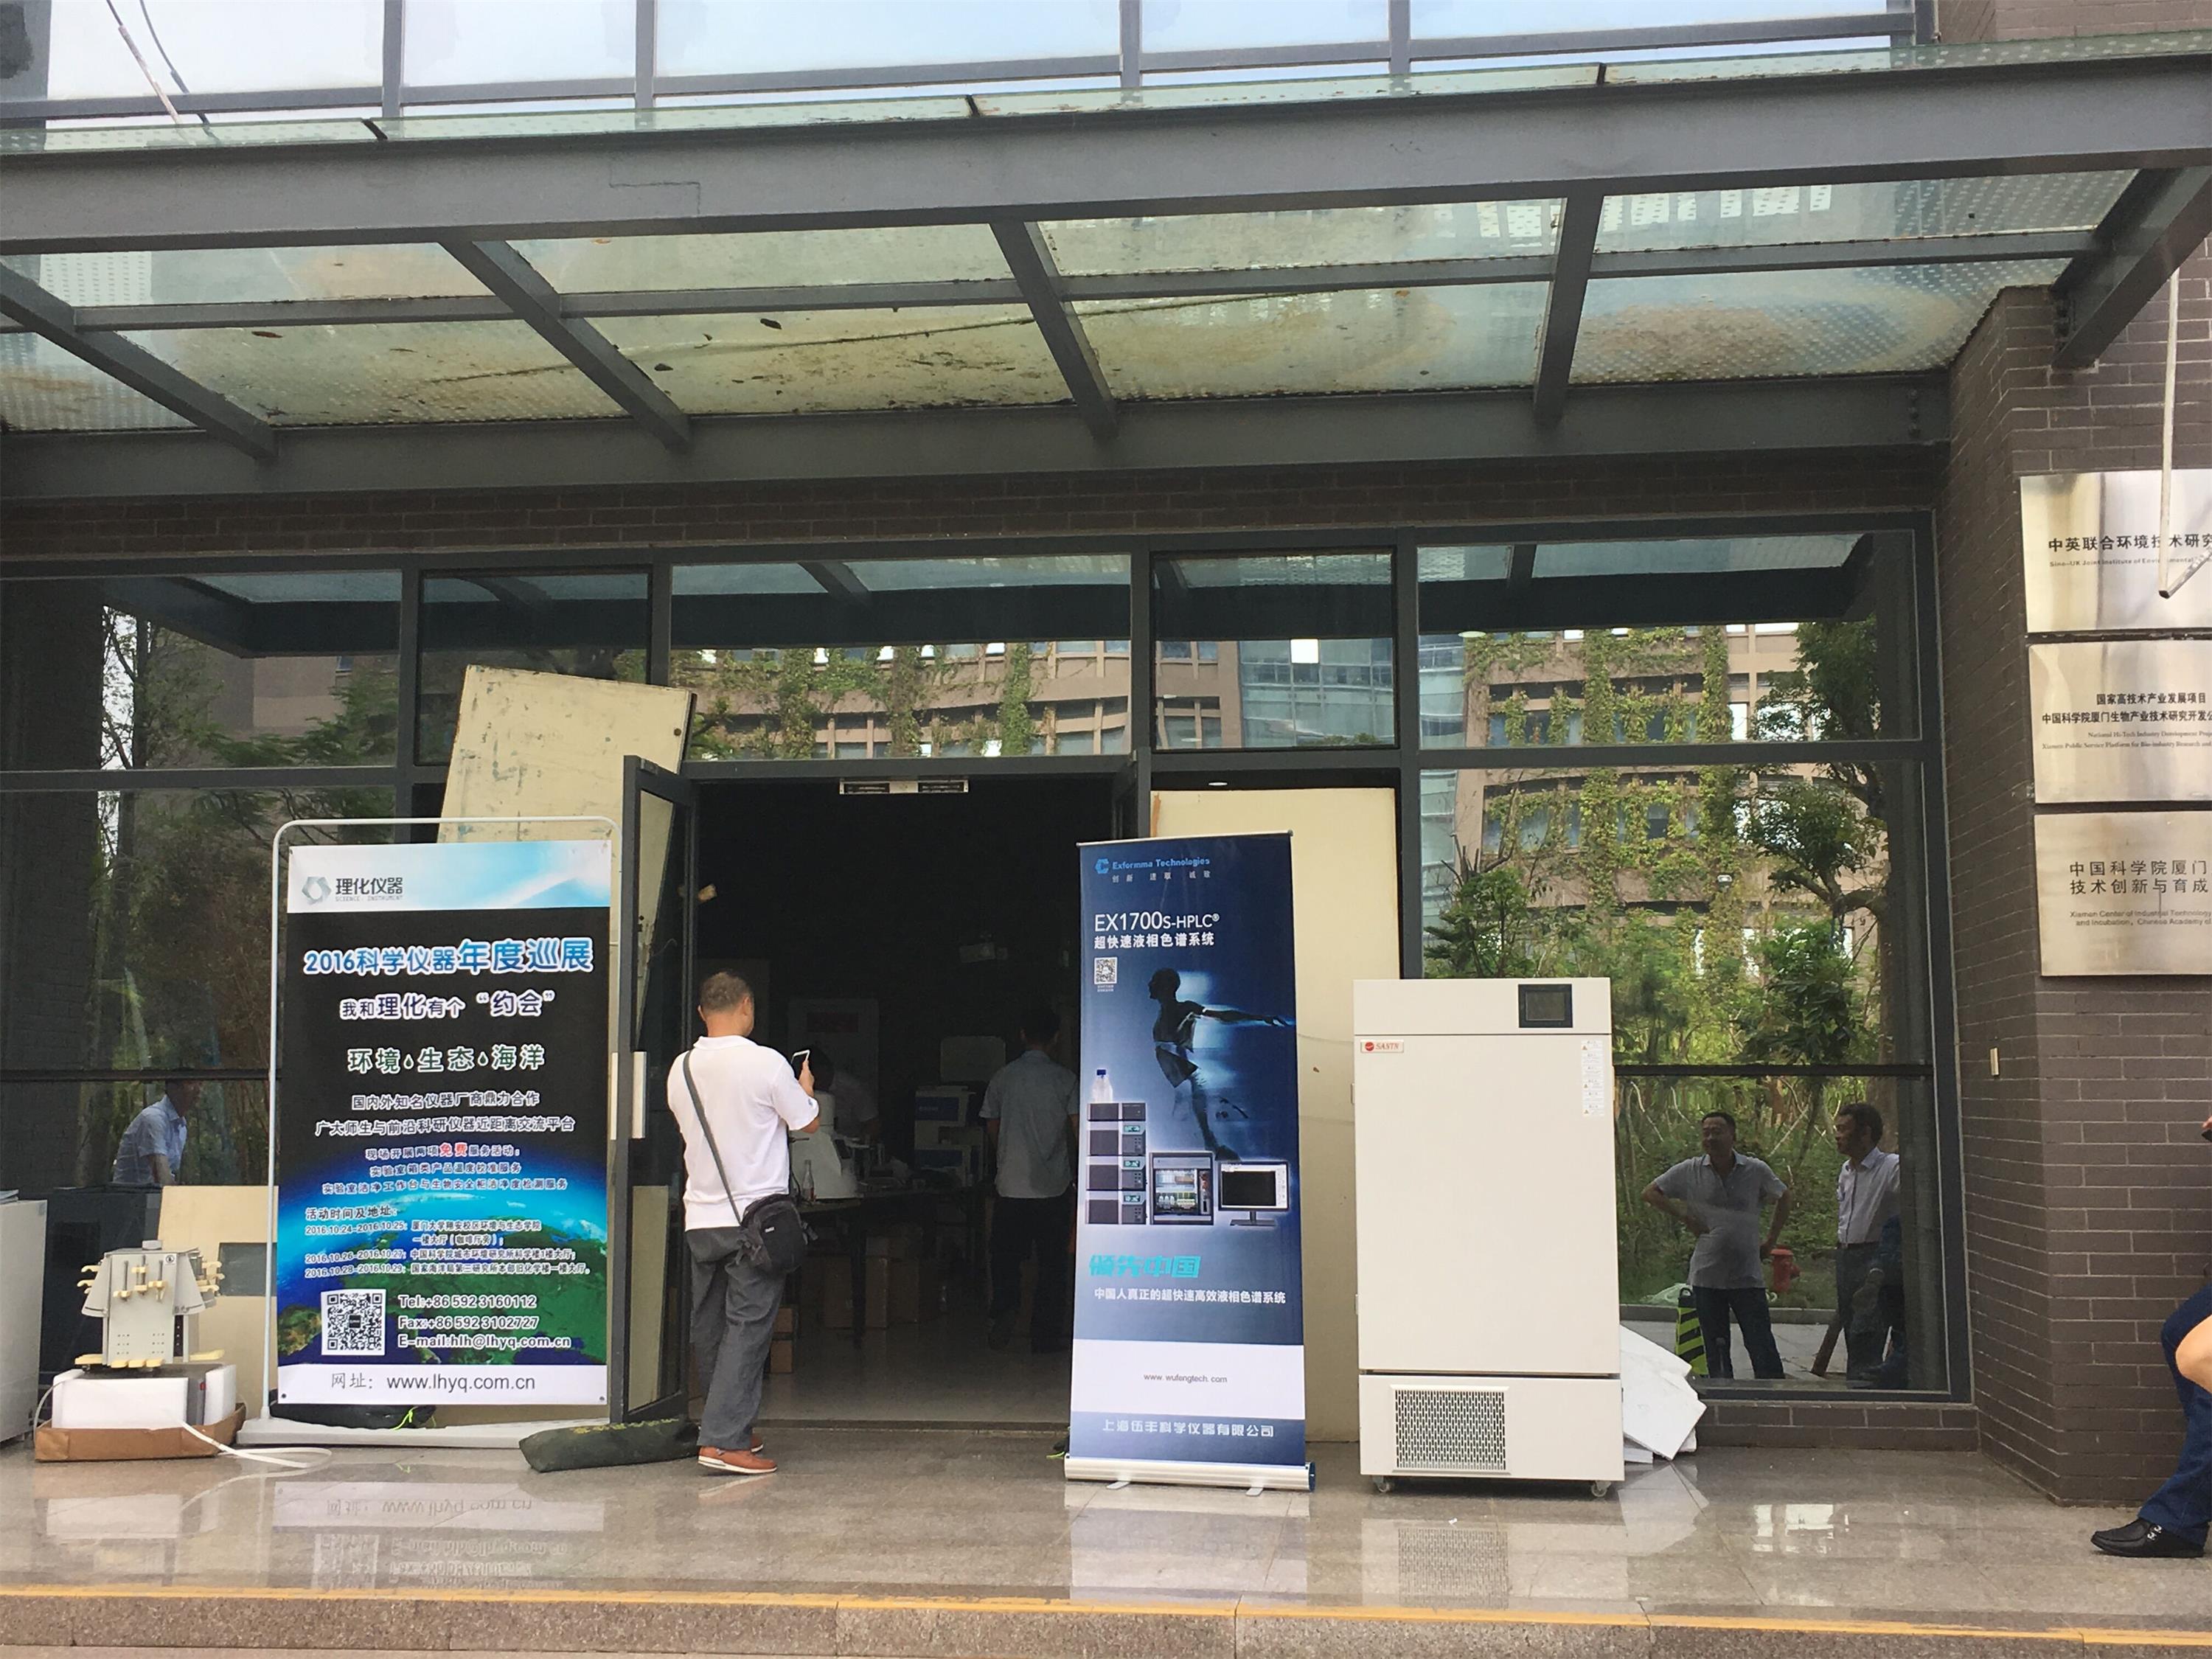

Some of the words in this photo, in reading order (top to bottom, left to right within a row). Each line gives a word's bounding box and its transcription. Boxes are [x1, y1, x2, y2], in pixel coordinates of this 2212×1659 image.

[2096, 692, 2206, 705] 国家高技术产业发展项目
[1112, 860, 1153, 870] Exformma
[1155, 857, 1211, 868] Technologies
[335, 877, 403, 896] 理化仪器
[2070, 877, 2209, 895] 技术创新与育成
[1094, 931, 1215, 950] 超快速液相色谱系统
[304, 937, 594, 975] 2016科学仪器年度巡展
[351, 1090, 540, 1110] 国内外知名仪器厂商鼎力合作
[315, 1116, 576, 1137] 广大师生与前沿科研仪器近距离交流平台
[1089, 1254, 1202, 1279] 领先中国
[1094, 1287, 1287, 1304] 中国人真正的超快速高效液相色谱系统
[386, 1373, 536, 1393] www.lhyq.com.cn
